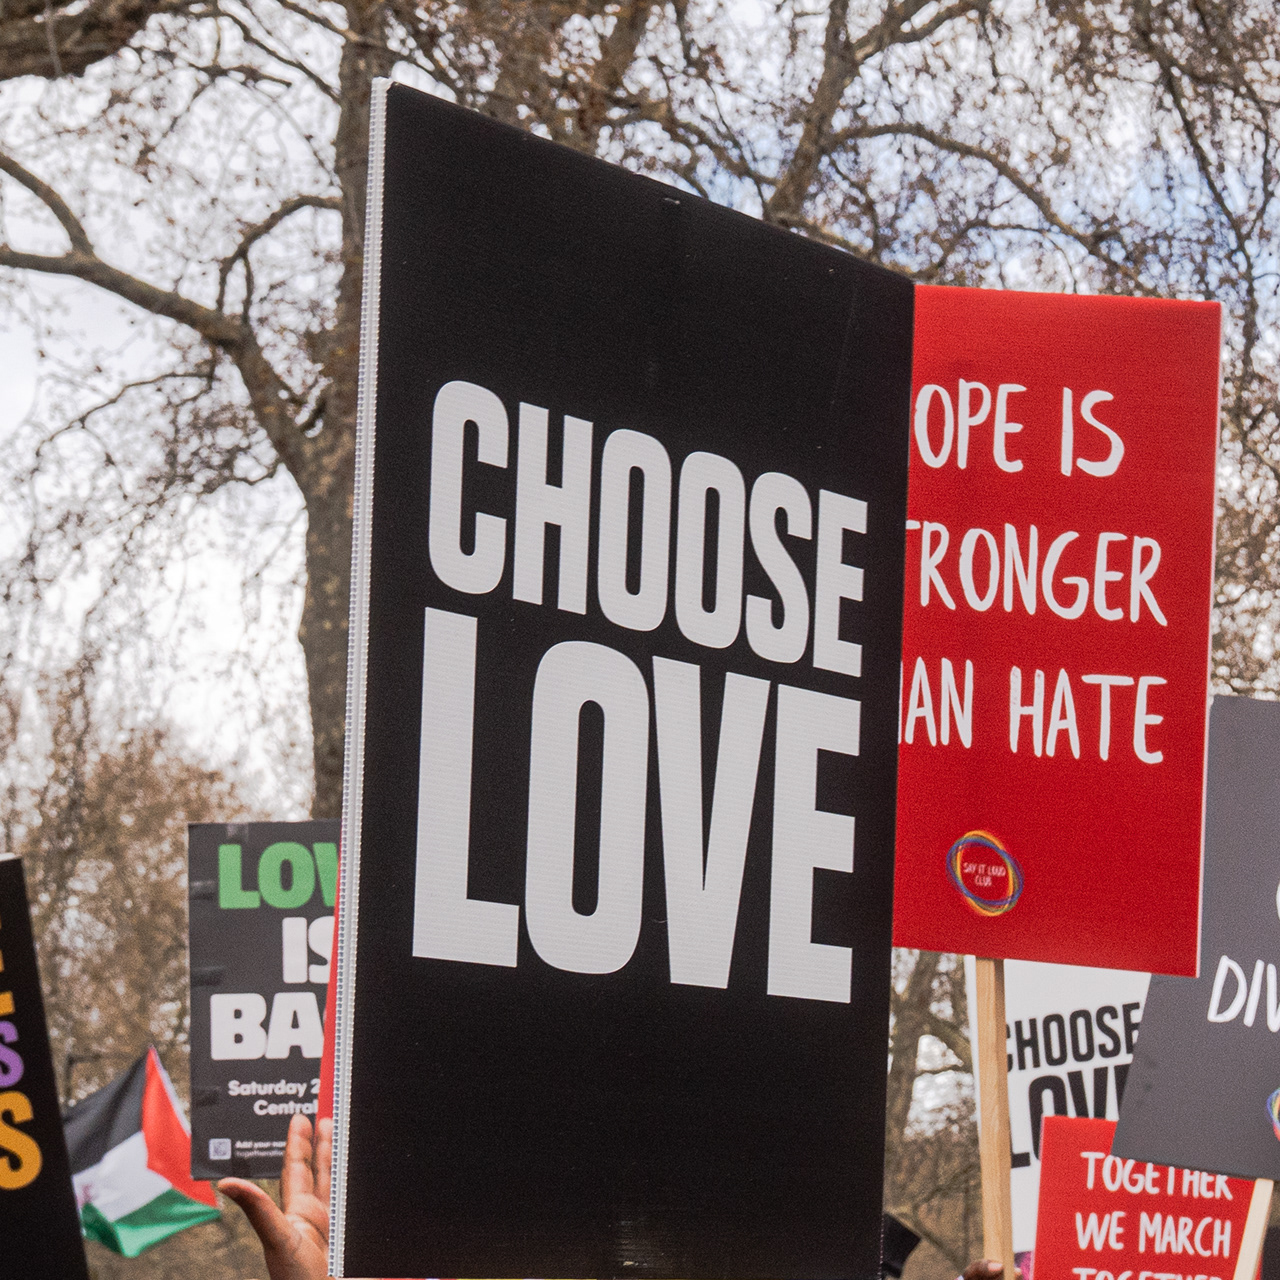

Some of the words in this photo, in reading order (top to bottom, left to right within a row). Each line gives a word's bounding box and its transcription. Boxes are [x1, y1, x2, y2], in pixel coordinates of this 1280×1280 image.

[1061, 387, 1124, 477] IS
[428, 380, 868, 678] CHOOSE
[898, 656, 973, 749] AN
[1009, 665, 1167, 765] HATE
[412, 607, 861, 1003] LOVE
[210, 992, 327, 1060] BA
[1007, 1002, 1140, 1073] HOOSE
[227, 1079, 308, 1099] Saturday
[253, 1099, 319, 1116] Central
[1081, 1151, 1233, 1201] TOGETHER
[1075, 1211, 1124, 1252] WE
[1139, 1217, 1231, 1258] MARCH
